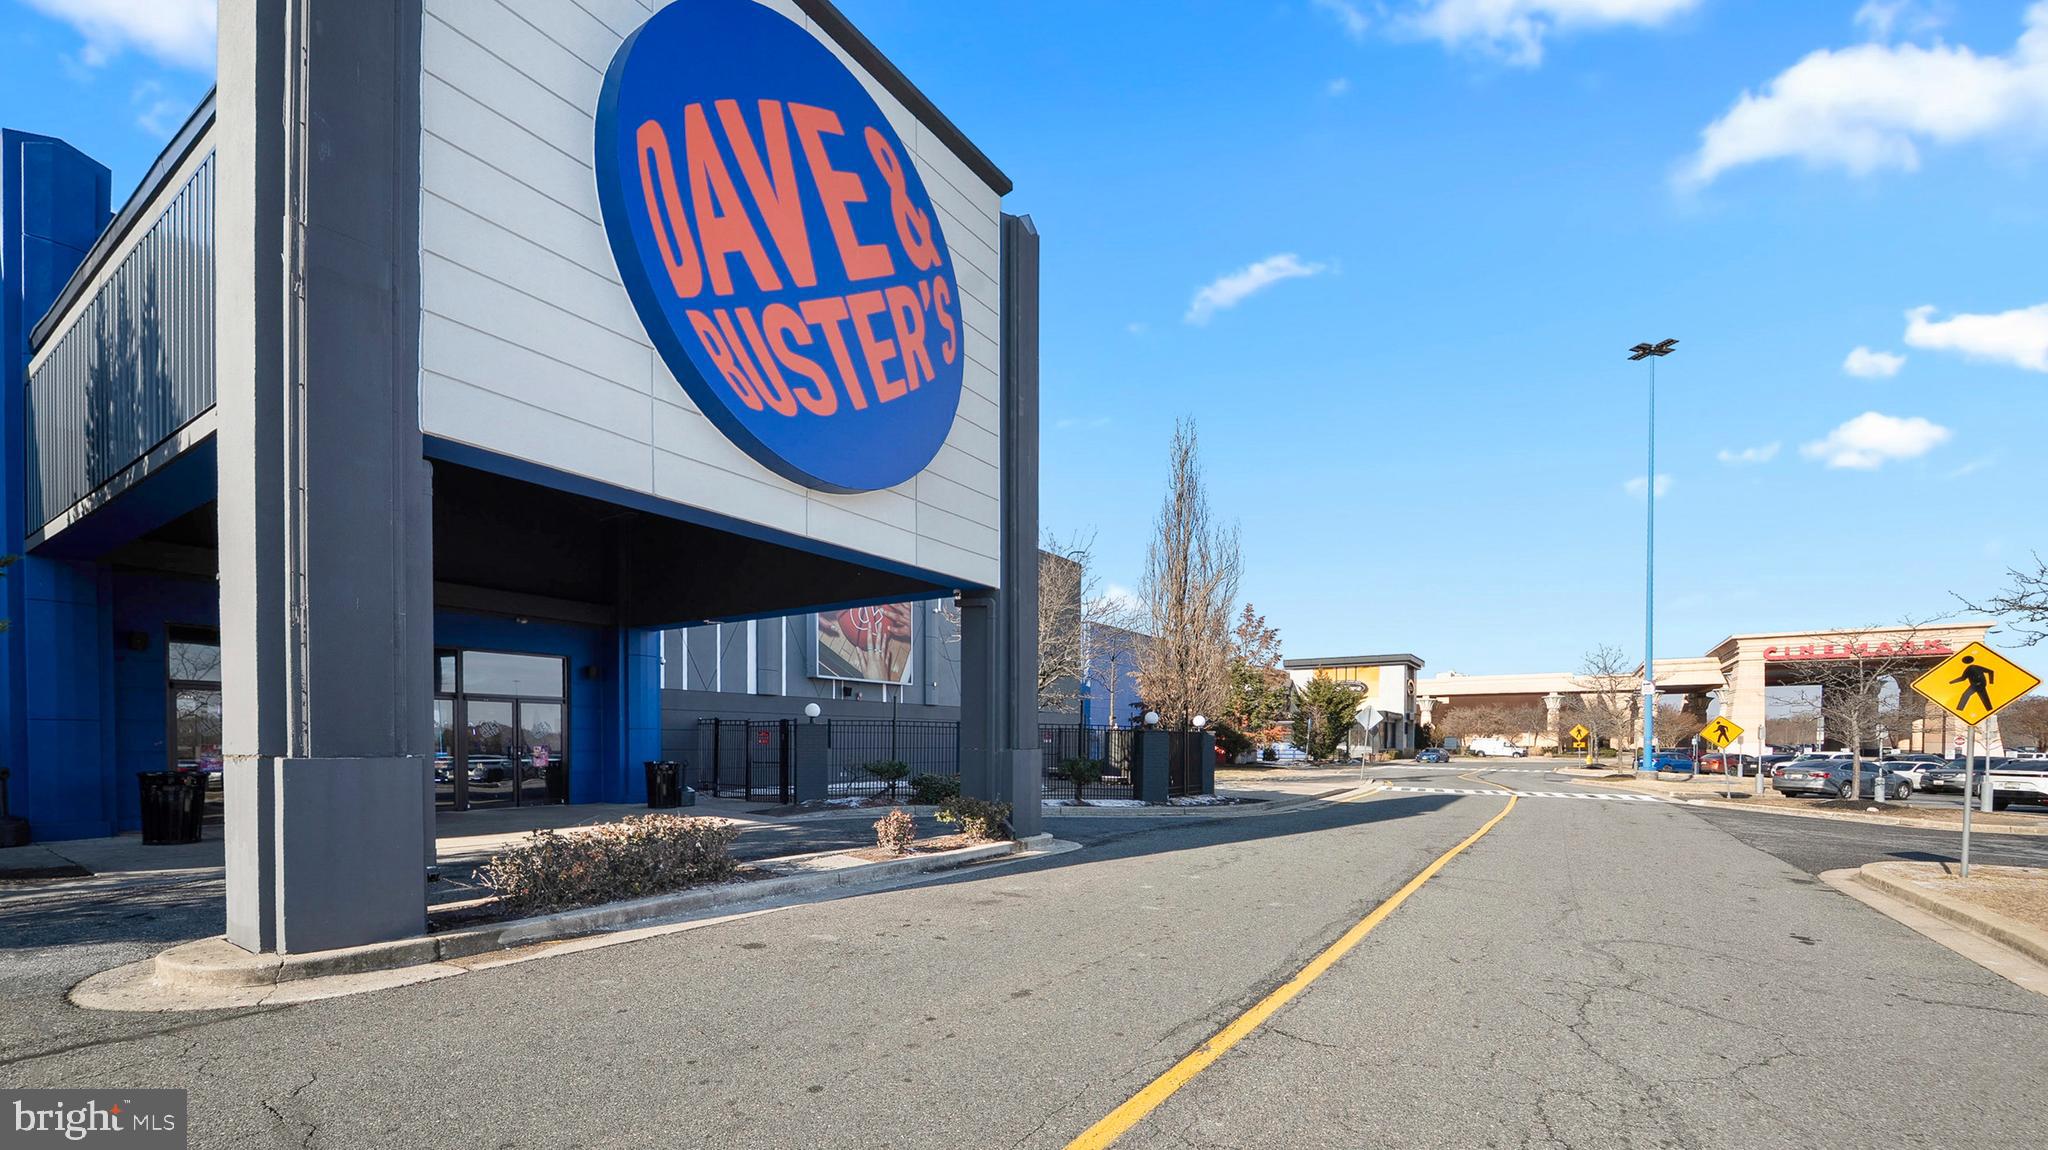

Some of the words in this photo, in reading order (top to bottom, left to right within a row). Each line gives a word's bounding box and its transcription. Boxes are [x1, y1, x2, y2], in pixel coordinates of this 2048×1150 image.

[636, 98, 896, 299] DAVE
[862, 125, 943, 272] &
[685, 274, 957, 418] BUSTER'S
[1763, 639, 1954, 661] CINEMARK
